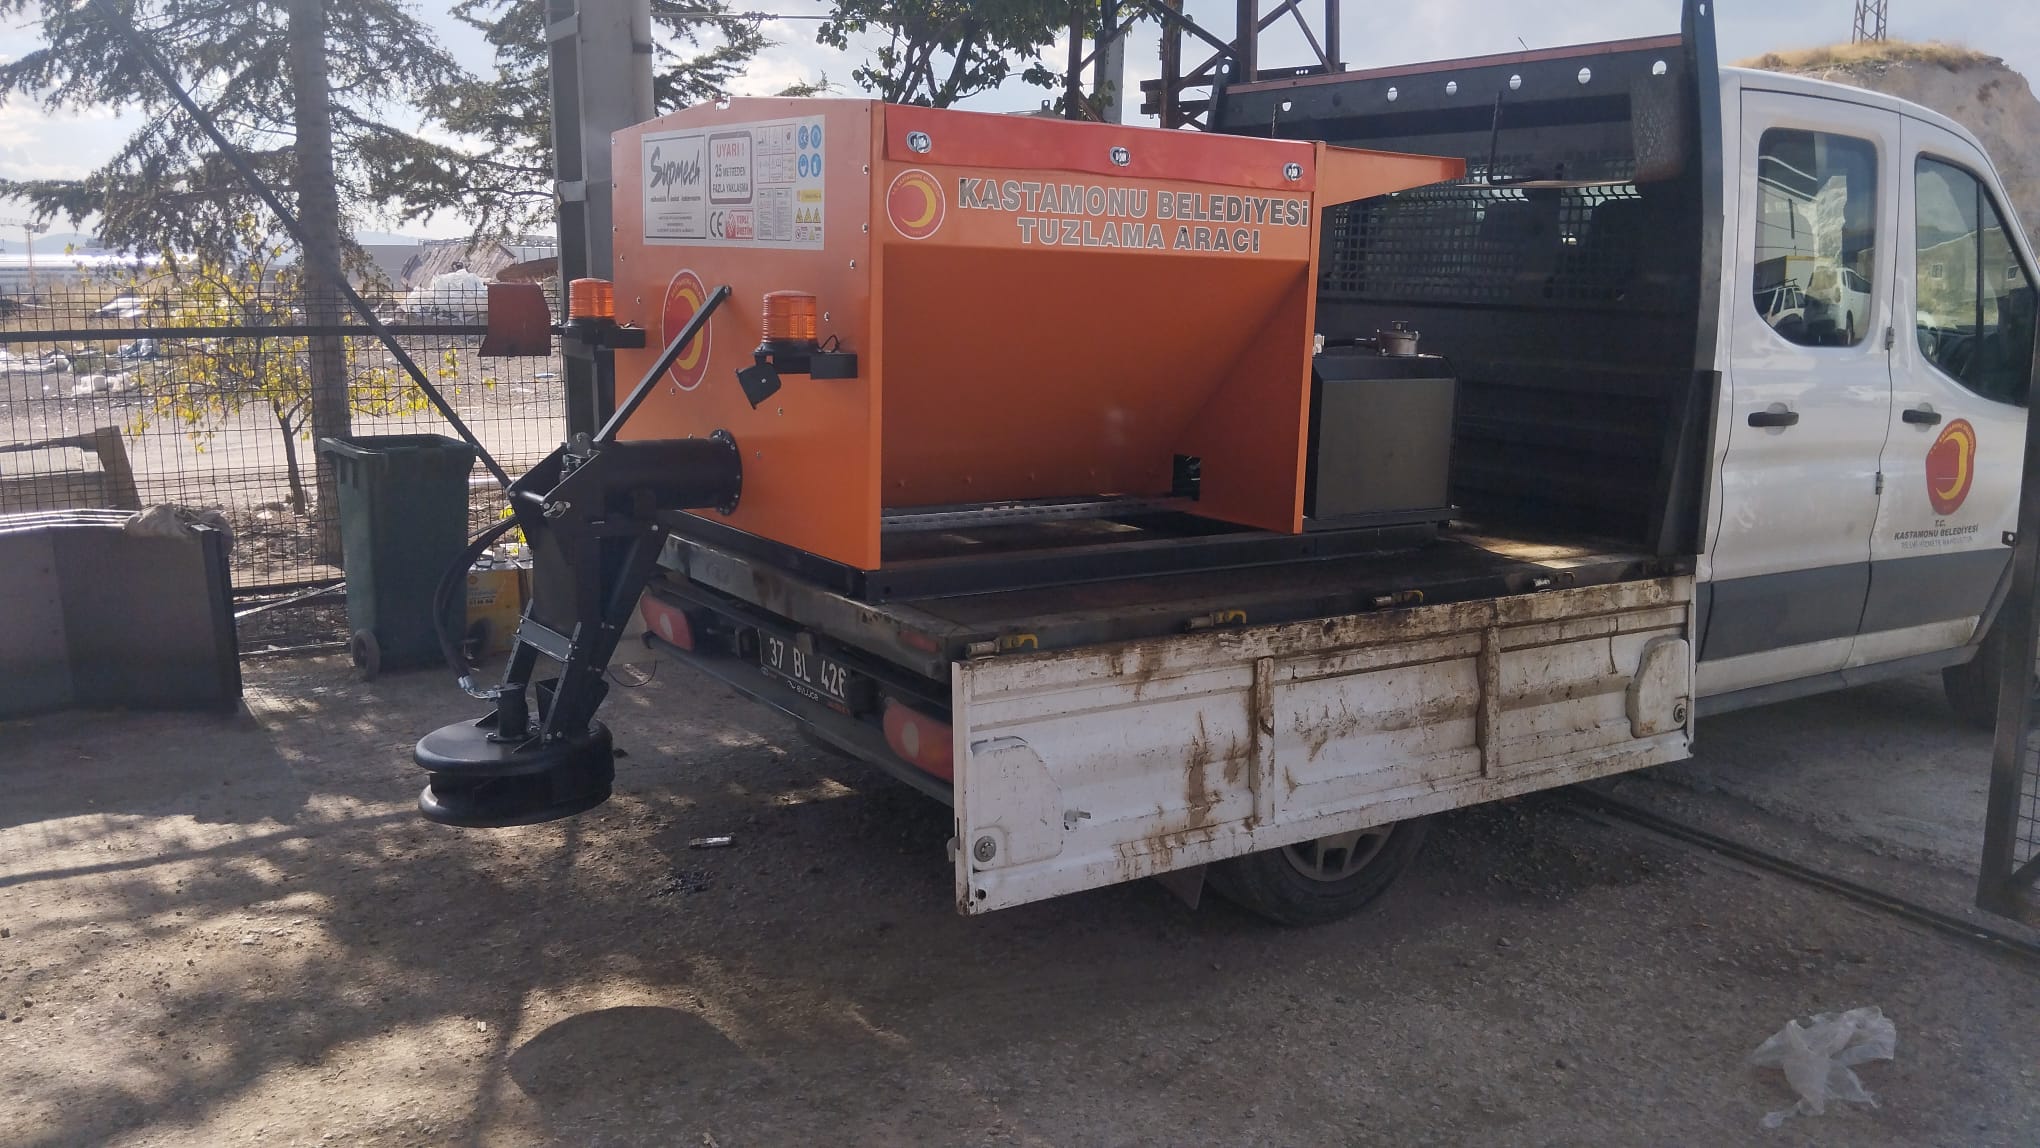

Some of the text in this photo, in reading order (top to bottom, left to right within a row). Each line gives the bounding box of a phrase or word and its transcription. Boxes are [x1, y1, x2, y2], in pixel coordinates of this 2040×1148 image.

[650, 146, 700, 201] Supmech
[714, 163, 722, 178] 25
[958, 177, 1148, 219] KASTAMONU
[1017, 216, 1260, 253] TUZLAMA ARACI
[1894, 529, 1939, 541] KASTAMONU
[769, 637, 784, 669] 37
[793, 648, 810, 683] BL
